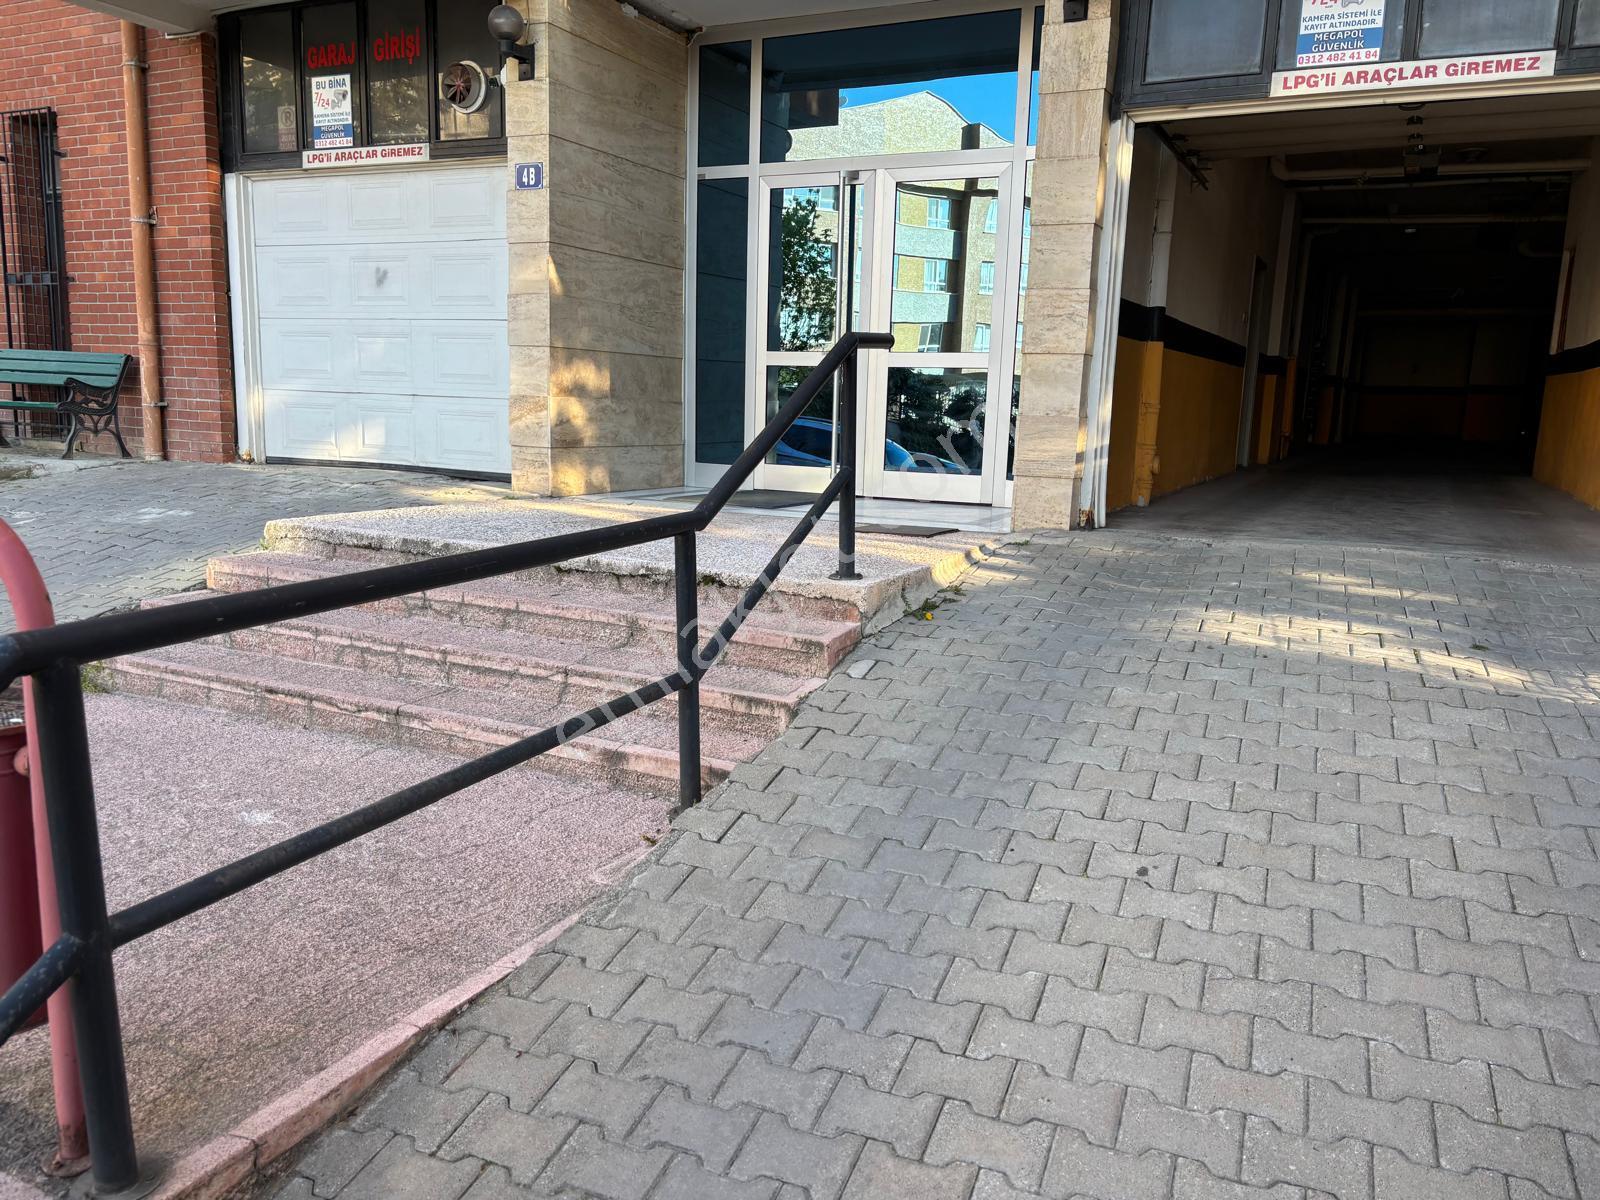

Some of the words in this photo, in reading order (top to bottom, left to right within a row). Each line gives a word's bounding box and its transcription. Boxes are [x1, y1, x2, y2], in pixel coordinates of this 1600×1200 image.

[1302, 13, 1336, 24] KAMERA
[1337, 8, 1369, 20] SİSTEMİ
[1370, 8, 1382, 17] İLE
[1303, 22, 1327, 31] KAYIT
[1314, 29, 1365, 42] MEGAPOL
[1312, 39, 1365, 53] GÜVENLİK
[307, 40, 356, 69] GARAJ
[1298, 54, 1324, 66] 0312
[1326, 52, 1346, 63] 482
[1348, 51, 1362, 61] 41
[1364, 49, 1378, 60] 84
[1341, 64, 1438, 86] ARAÇLAR
[315, 80, 327, 90] BU
[328, 77, 347, 89] BİNA
[314, 91, 330, 108] 7/24
[334, 149, 378, 163] ARAÇLAR
